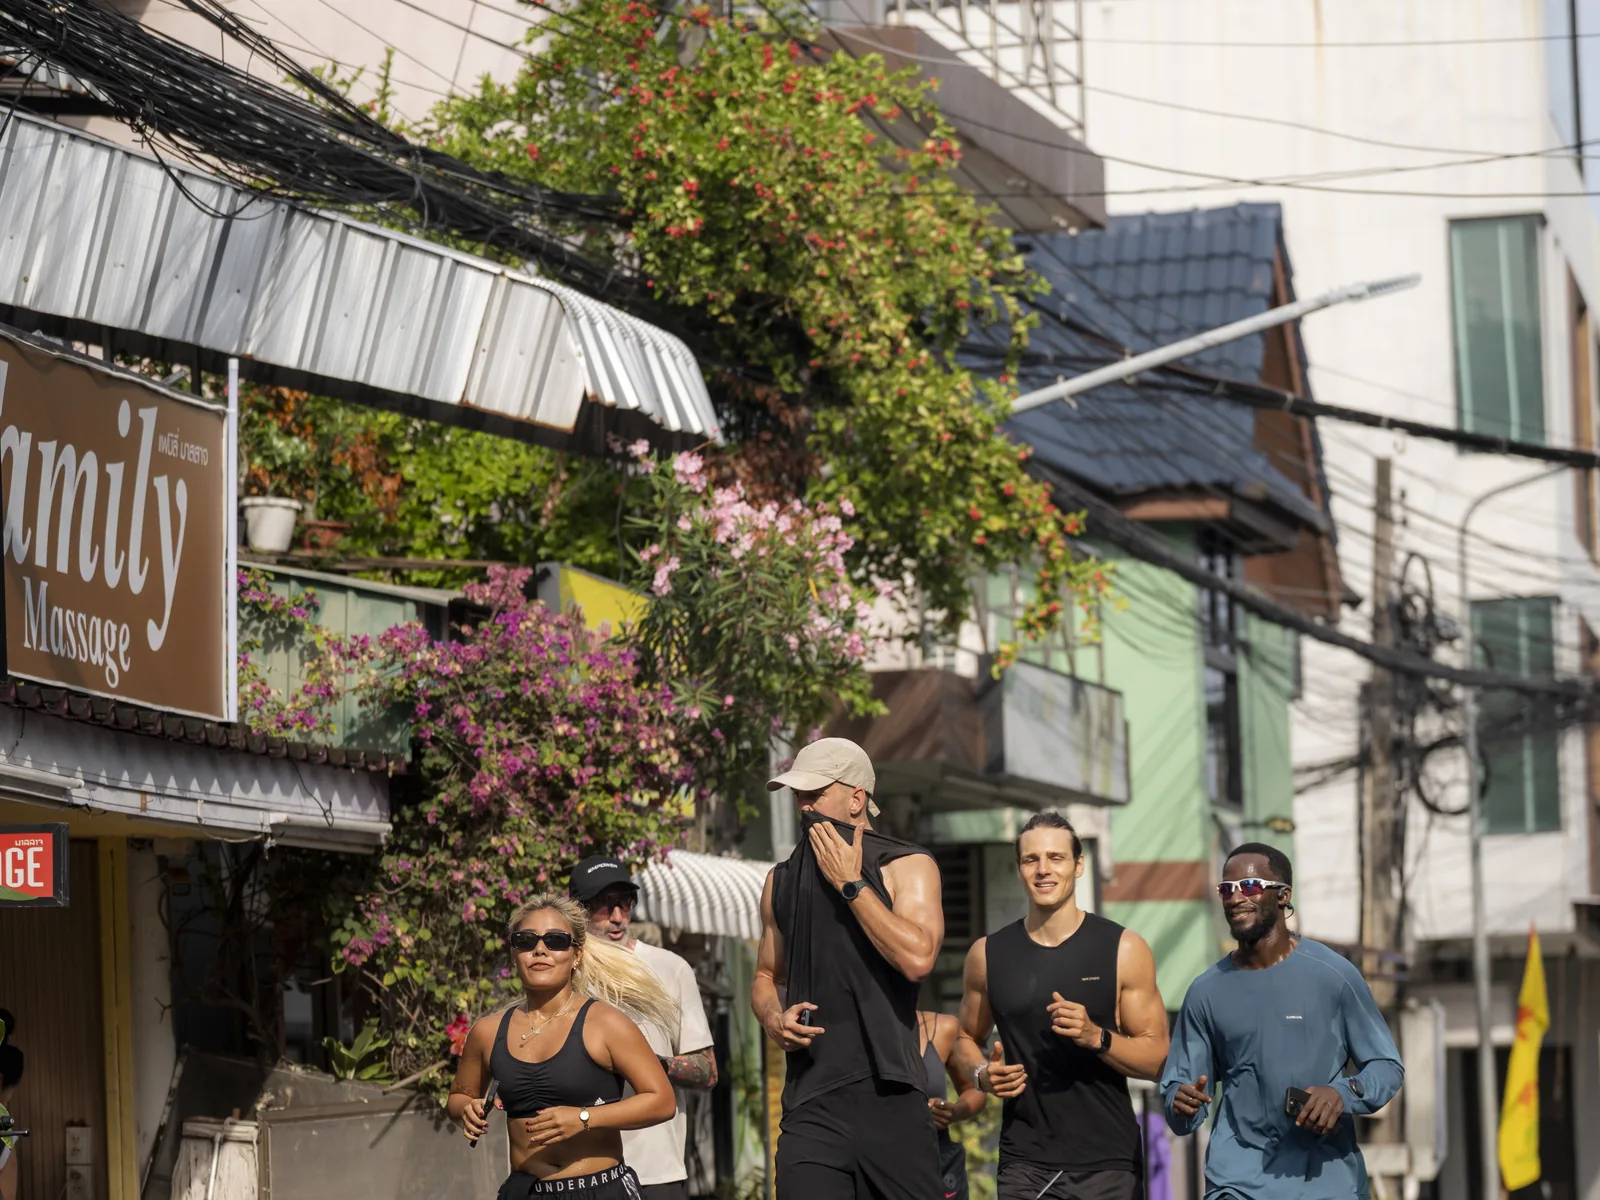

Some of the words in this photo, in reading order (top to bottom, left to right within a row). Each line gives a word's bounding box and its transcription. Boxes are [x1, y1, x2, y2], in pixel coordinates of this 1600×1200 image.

[0, 360, 188, 652] amily
[22, 576, 131, 688] Massage
[0, 846, 44, 888] GE
